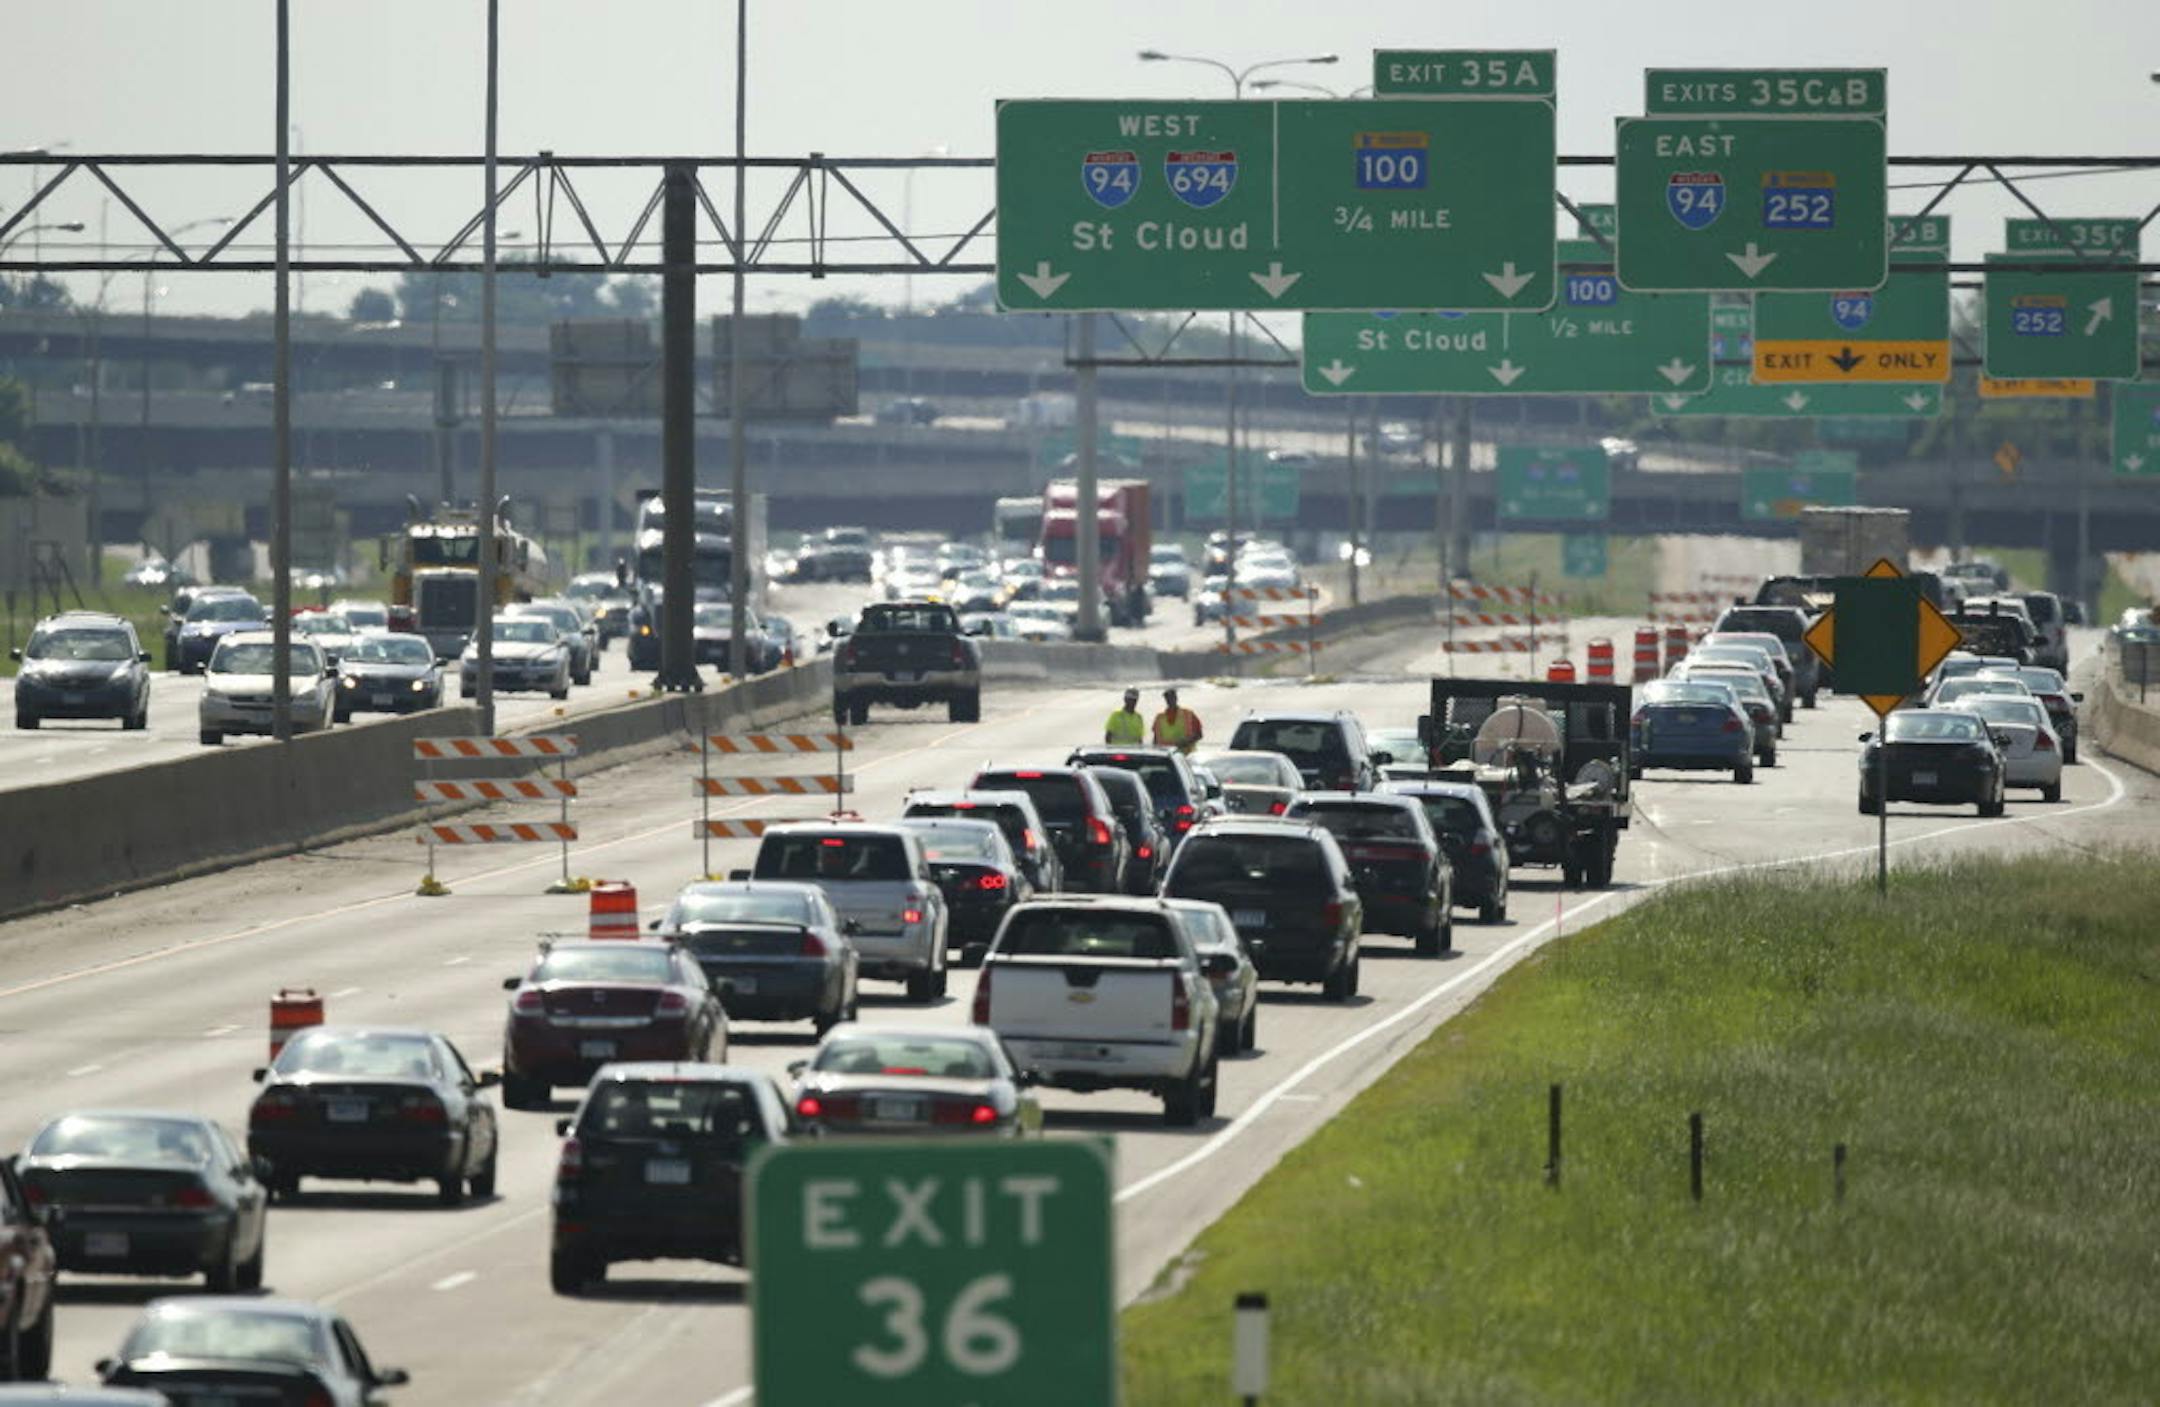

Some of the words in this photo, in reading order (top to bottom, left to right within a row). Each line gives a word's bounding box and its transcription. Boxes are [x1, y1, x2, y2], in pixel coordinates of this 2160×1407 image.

[1390, 64, 1446, 82] EXIT
[1461, 60, 1539, 86] 35A
[1662, 83, 1737, 102] EXITS
[1751, 79, 1868, 105] 35C&B
[1119, 115, 1200, 136] WEST
[1656, 135, 1735, 156] EAST
[1091, 167, 1132, 193] 94
[1173, 167, 1229, 193] 694
[1363, 155, 1418, 183] 100
[1676, 187, 1719, 214] 94
[1768, 195, 1830, 222] 252
[1334, 207, 1373, 232] 3/4
[1390, 210, 1451, 228] MILE
[1073, 221, 1114, 250] St
[1136, 221, 1248, 250] Cloud
[2072, 225, 2126, 246] 35C
[1569, 280, 1612, 300] 100
[1836, 302, 1868, 320] 94
[2016, 312, 2062, 332] 252
[1357, 330, 1388, 350] St
[1405, 330, 1487, 351] Cloud
[1551, 318, 1579, 338] 1/2
[1588, 320, 1633, 335] MILE
[1764, 353, 1813, 369] EXIT
[1878, 353, 1936, 370] ONLY
[803, 1177, 1058, 1248] EXIT
[854, 1273, 1021, 1376] 36
